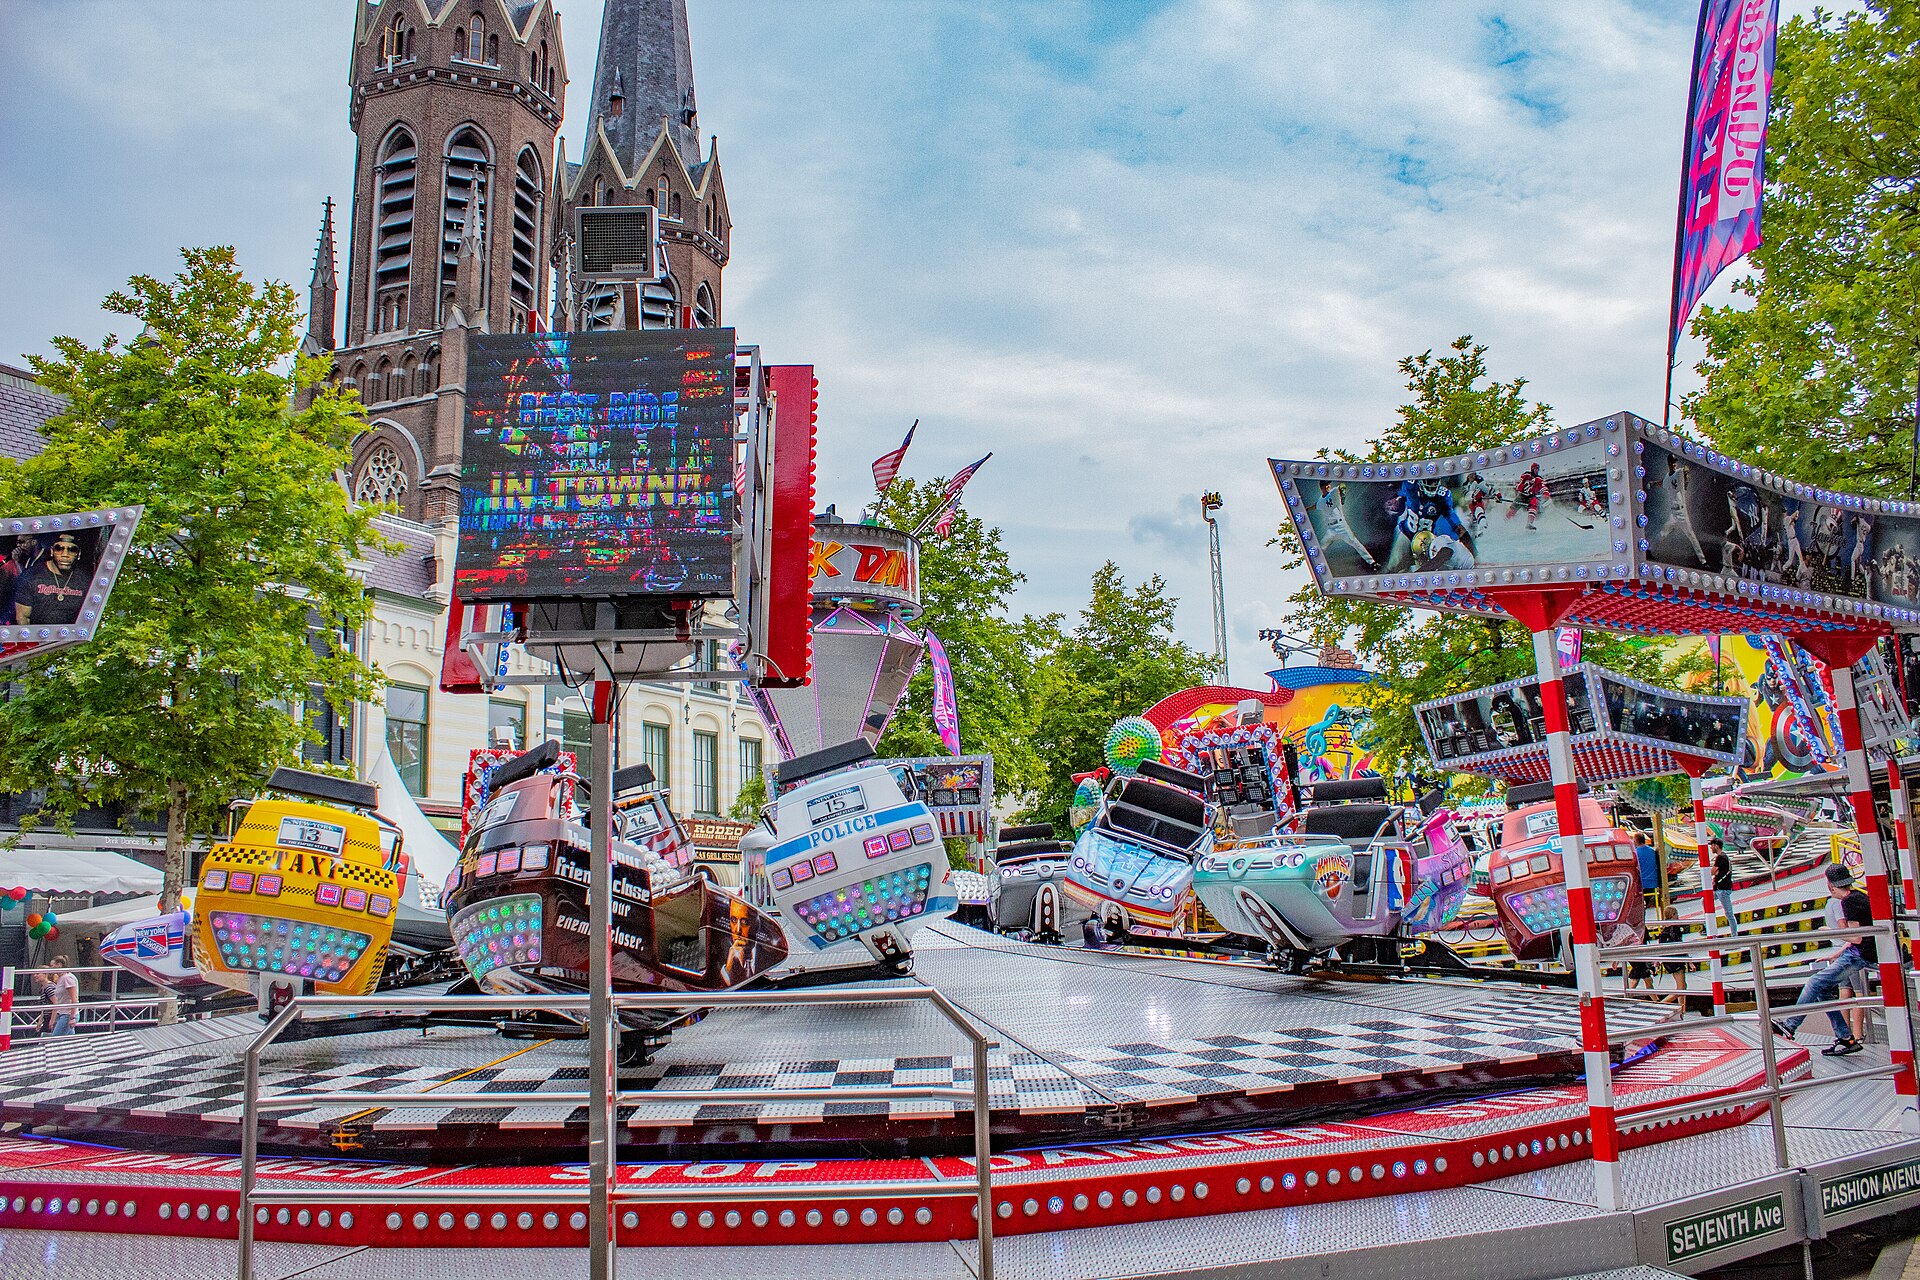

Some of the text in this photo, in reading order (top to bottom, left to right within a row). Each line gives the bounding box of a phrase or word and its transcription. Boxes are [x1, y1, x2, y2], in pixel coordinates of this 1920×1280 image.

[608, 391, 678, 430] RIDE
[490, 471, 536, 511] IN
[825, 797, 846, 813] 15
[299, 827, 321, 843] 13
[630, 815, 647, 828] 14
[694, 824, 743, 836] RODEO
[810, 814, 876, 848] POLICE
[271, 850, 340, 880] TAXI
[706, 852, 721, 860] GRILL
[1315, 855, 1350, 882] KNICKS
[612, 876, 651, 903] close
[149, 927, 167, 935] YORK
[140, 937, 167, 955] RANGERS
[959, 1126, 1353, 1170] DANGER
[550, 1160, 818, 1181] STOP
[1822, 1177, 1880, 1211] FASHION
[1672, 1204, 1782, 1255] SEVENTH Ave
